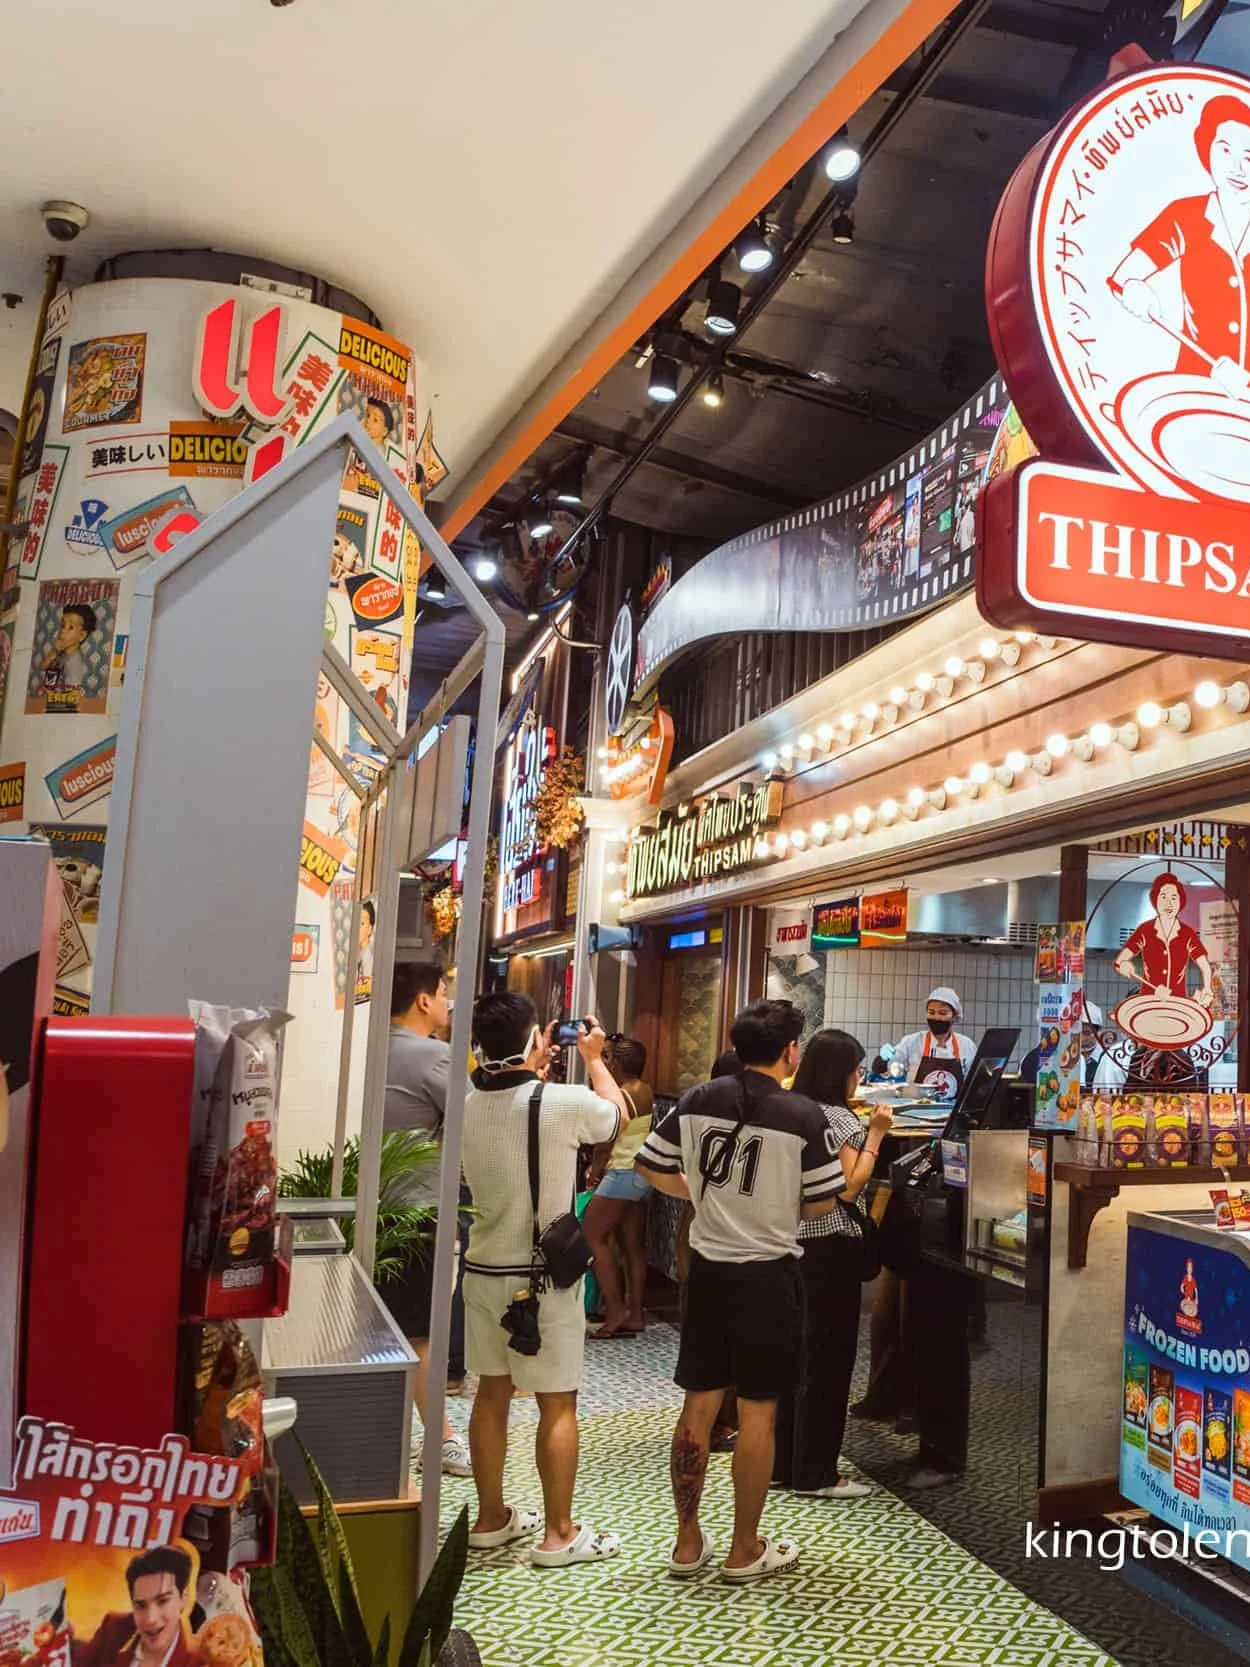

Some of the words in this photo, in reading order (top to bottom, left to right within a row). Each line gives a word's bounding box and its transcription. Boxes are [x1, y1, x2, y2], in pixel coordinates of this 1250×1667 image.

[1081, 89, 1184, 170] ทิพย์สมัย
[341, 330, 408, 384] DELICIOUS
[92, 443, 165, 469] 美味しい
[22, 463, 58, 563] 美味的
[700, 1126, 764, 1197] 01
[1137, 1311, 1197, 1369] FROZEN
[1199, 1347, 1250, 1375] FOOD
[23, 1426, 239, 1503] ไส้กรอกไทย
